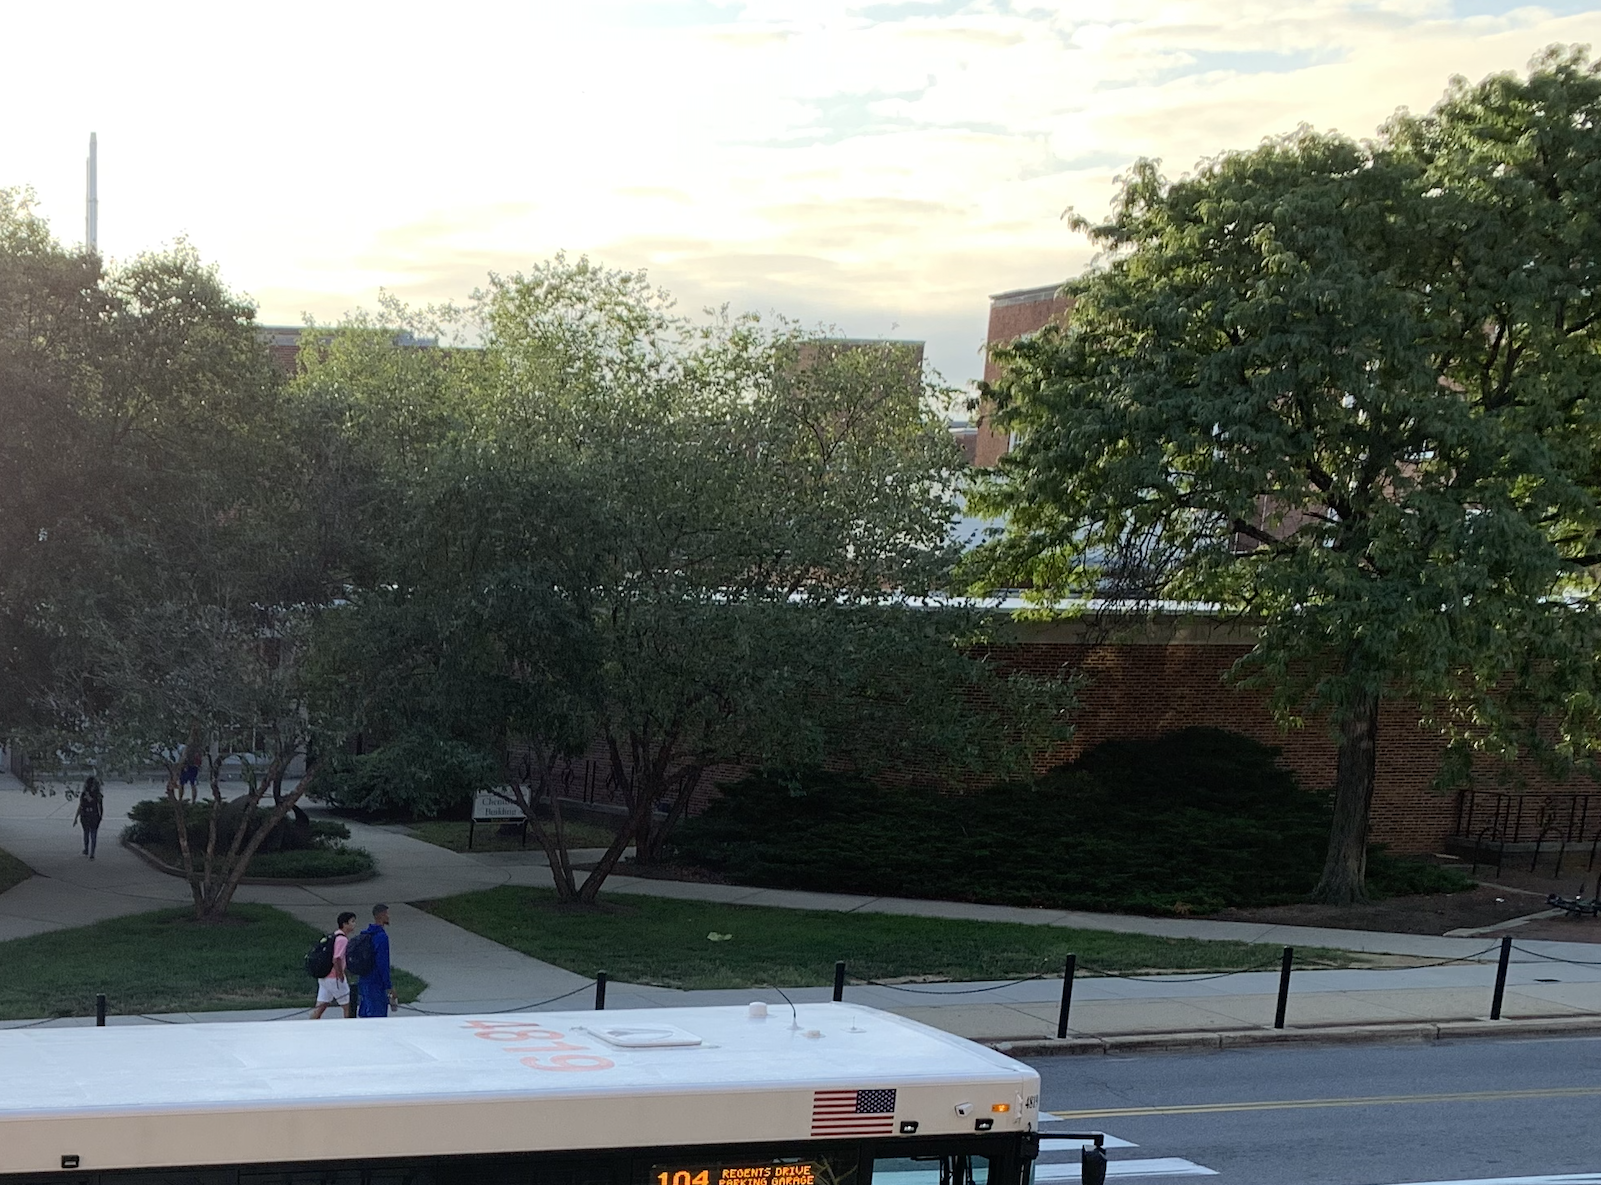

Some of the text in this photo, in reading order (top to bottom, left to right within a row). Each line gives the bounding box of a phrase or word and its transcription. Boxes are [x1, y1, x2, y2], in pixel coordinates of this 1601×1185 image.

[460, 1020, 615, 1072] 4819
[721, 1165, 812, 1179] REGENTS DRIVE
